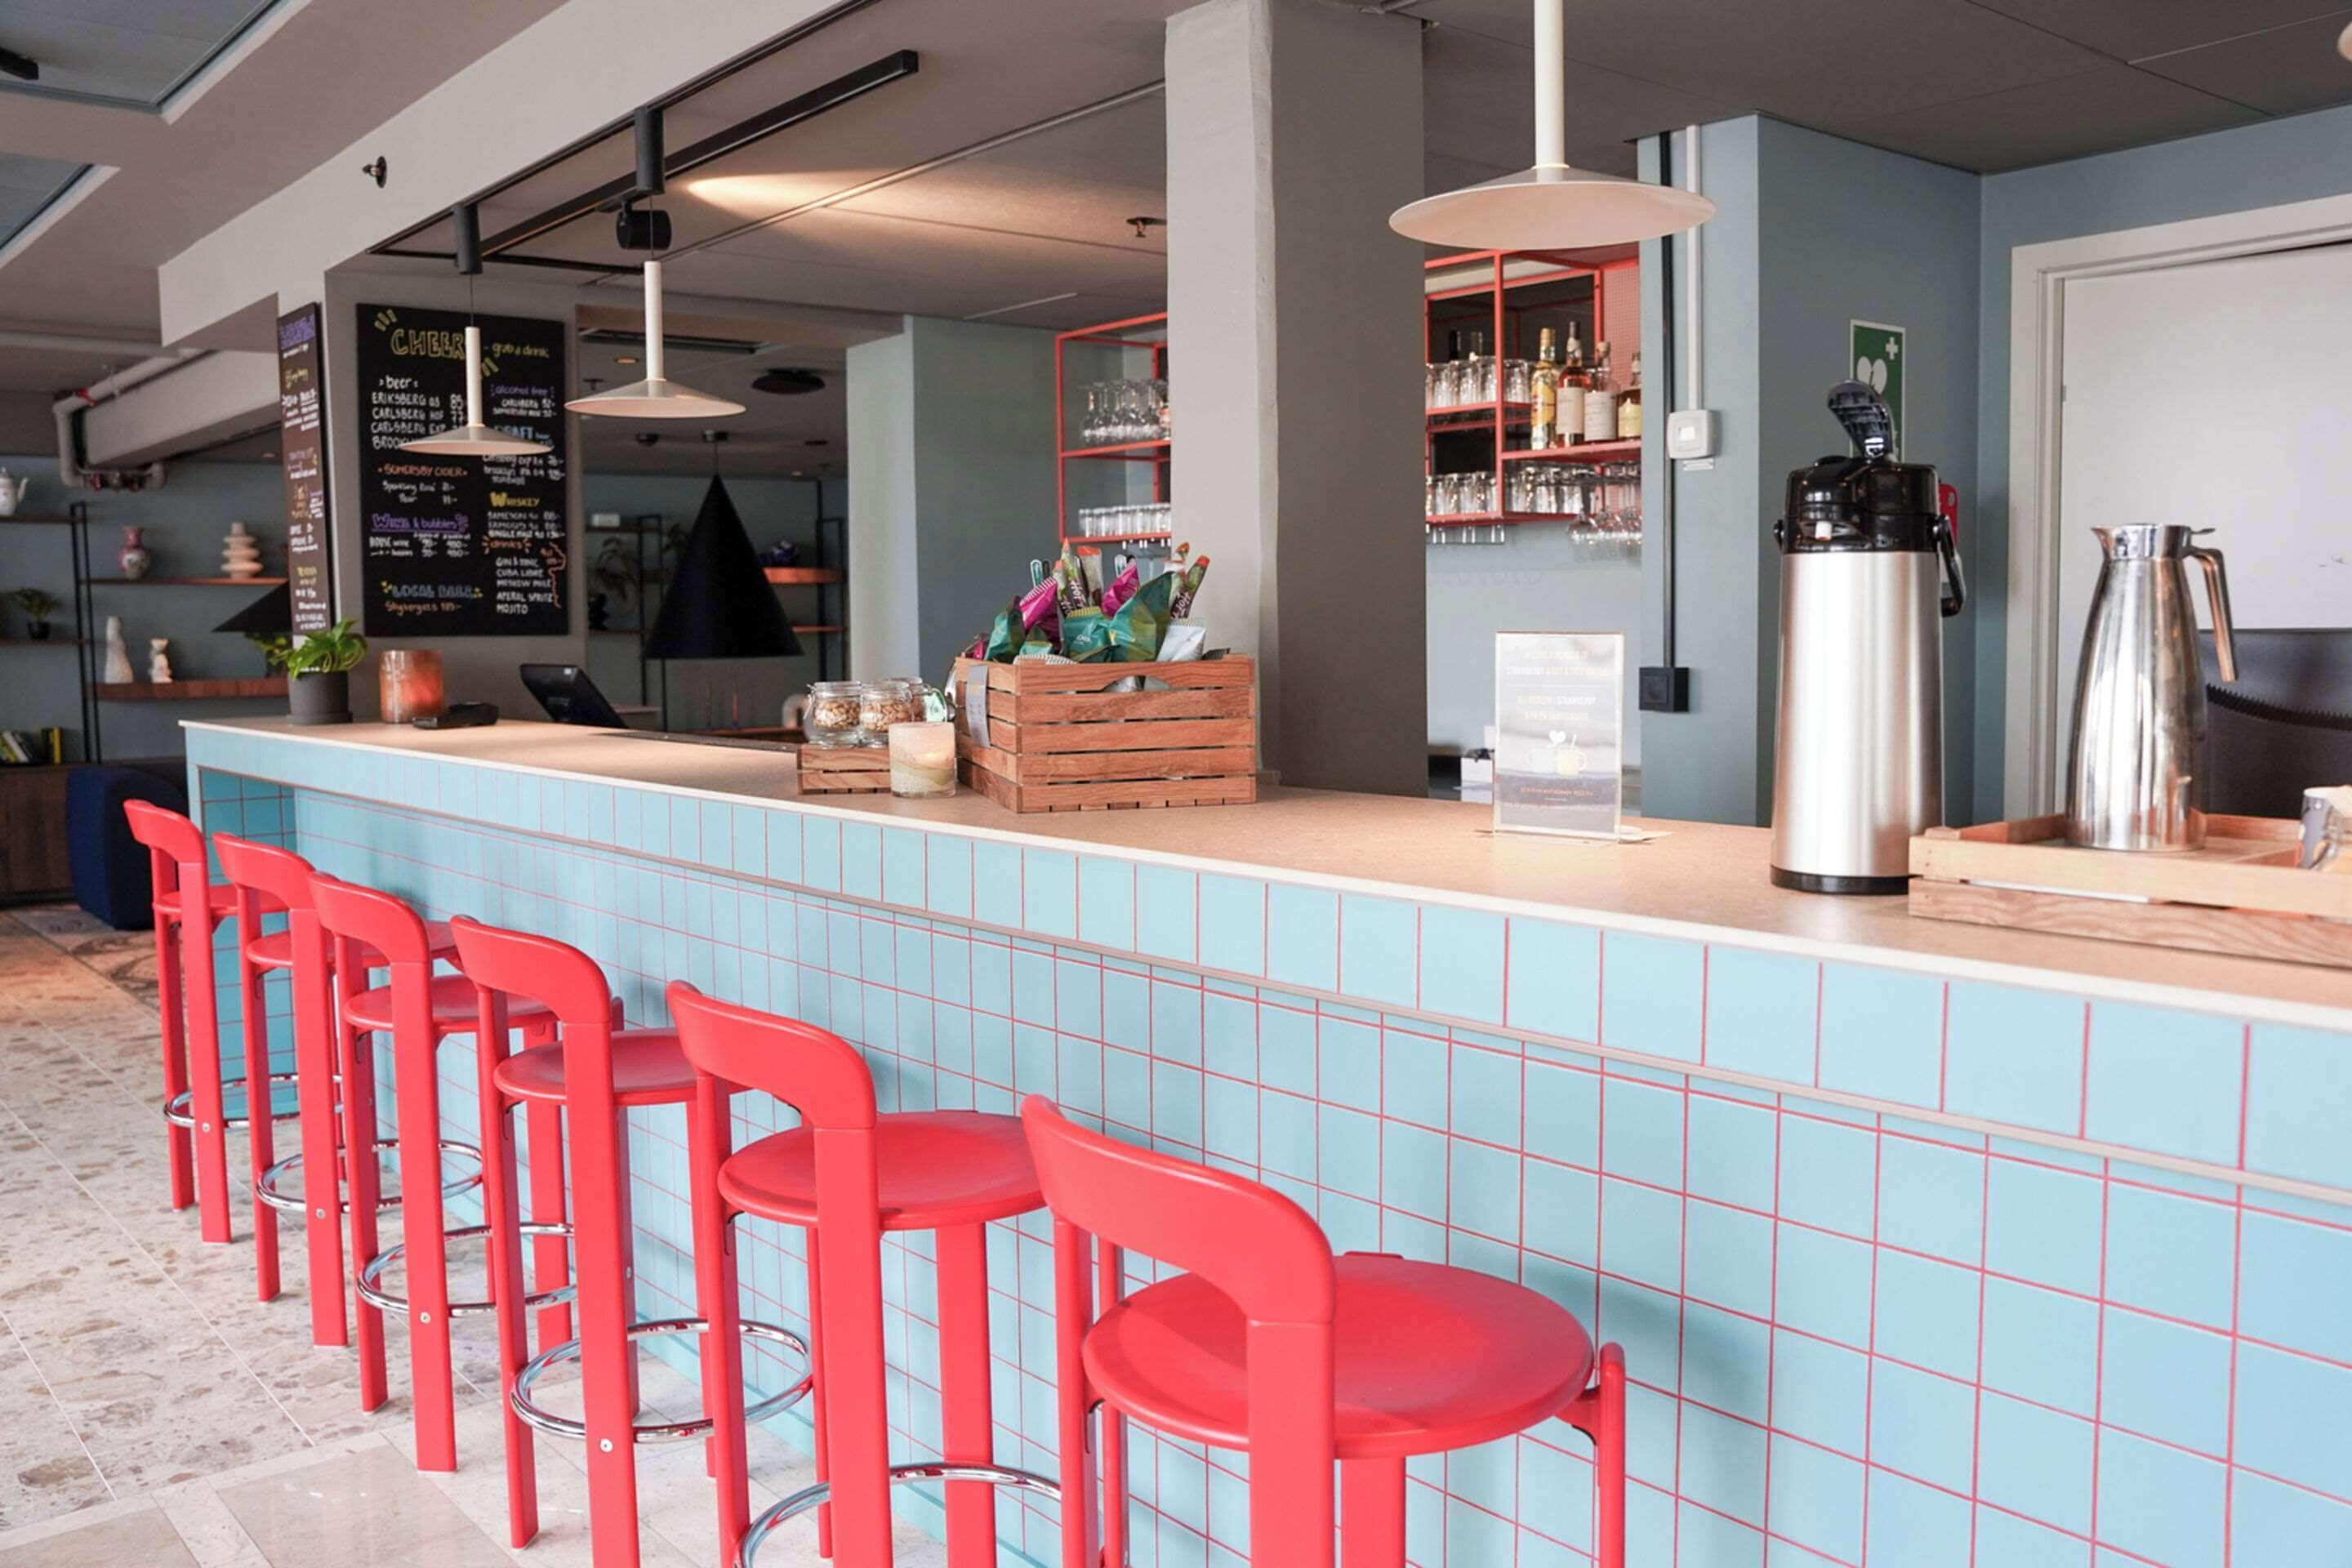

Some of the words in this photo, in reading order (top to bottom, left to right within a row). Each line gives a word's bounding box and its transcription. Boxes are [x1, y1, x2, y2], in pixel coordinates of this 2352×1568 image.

[390, 328, 466, 361] CHEER
[385, 375, 412, 390] beer
[372, 391, 426, 407] ERIKSBERG
[372, 407, 425, 421] CARLSBERG
[371, 421, 425, 435] CARLSBERG
[496, 604, 529, 615] MOJITO
